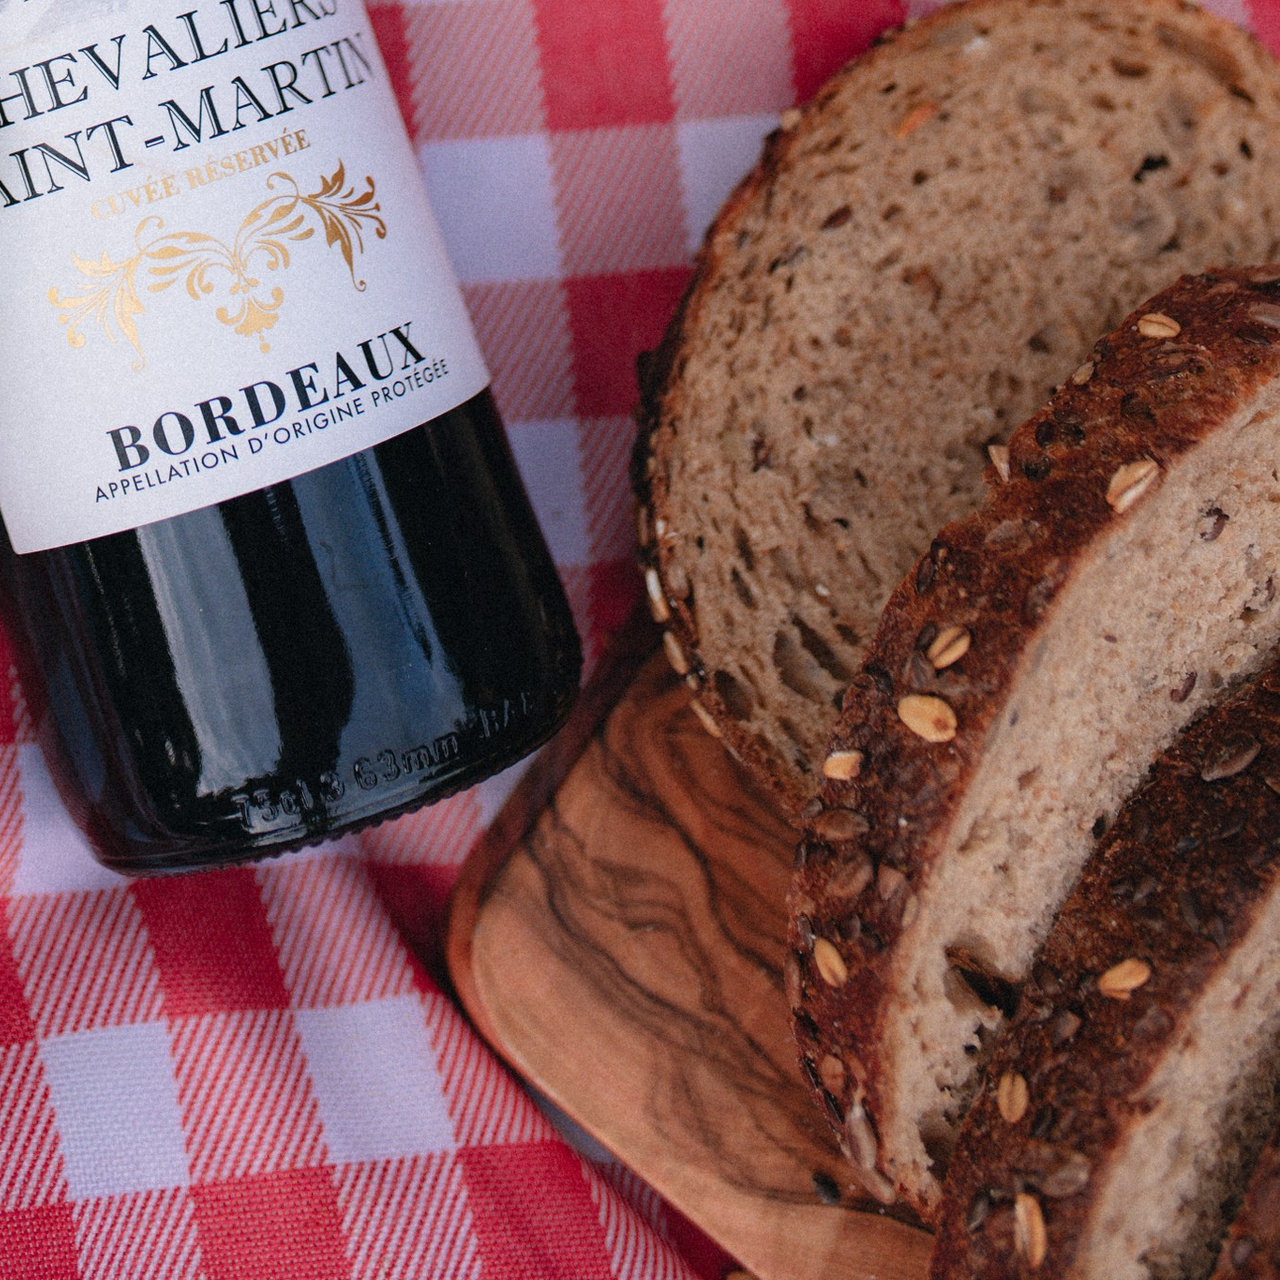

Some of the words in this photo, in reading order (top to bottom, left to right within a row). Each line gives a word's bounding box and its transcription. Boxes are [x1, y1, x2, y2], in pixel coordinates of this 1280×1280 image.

[91, 172, 181, 221] CUVÉE
[184, 127, 311, 190] RÉSERVÉE
[95, 444, 240, 504] APPELLATION
[370, 357, 450, 408] PROTÉGÉE
[106, 321, 426, 473] BORDEAUX
